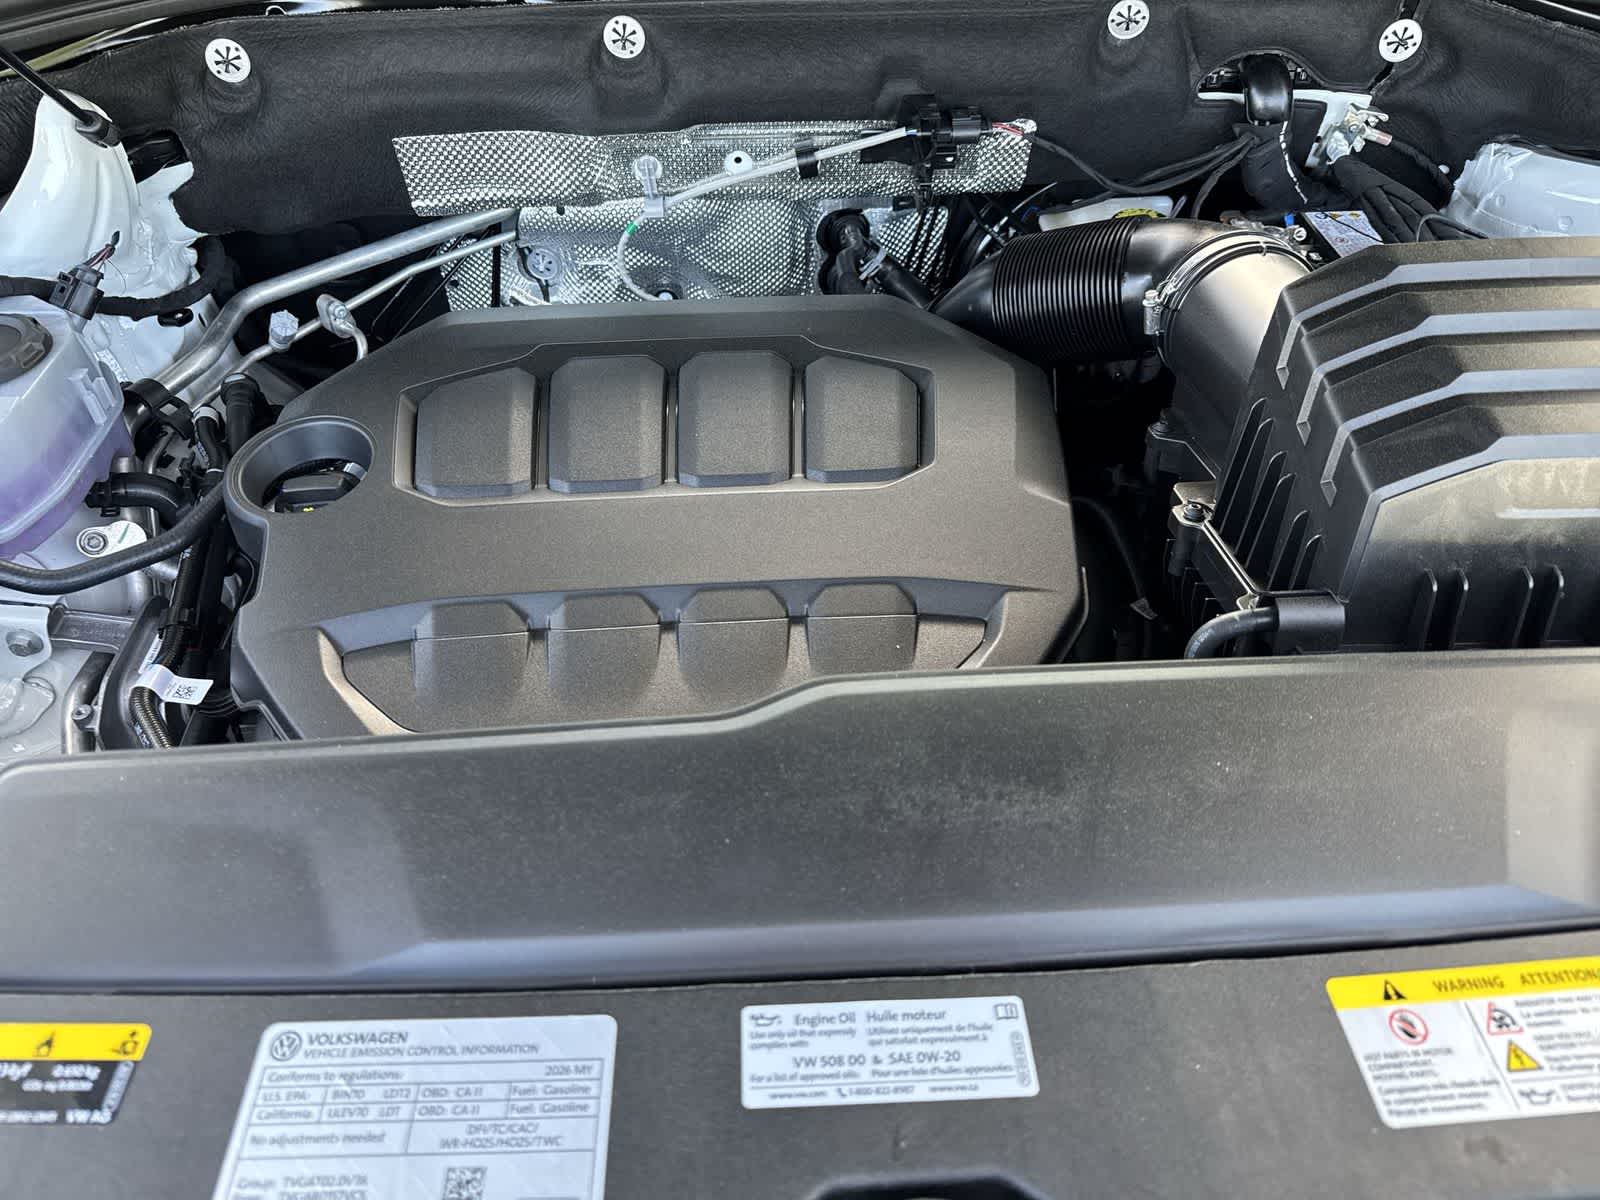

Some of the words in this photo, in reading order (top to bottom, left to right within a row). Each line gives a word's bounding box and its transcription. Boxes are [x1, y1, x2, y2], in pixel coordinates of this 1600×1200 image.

[1432, 975, 1505, 993] WARNING
[794, 1013, 837, 1027] Engine
[839, 1011, 857, 1024] Oil
[867, 1011, 899, 1023] Huile
[901, 1010, 946, 1022] moteur
[307, 1031, 409, 1046] VOLKSWAGEN
[304, 1047, 348, 1059] VEHICLE
[352, 1046, 404, 1058] EMISSION
[407, 1045, 457, 1057] CONTROL
[461, 1044, 540, 1056] INFORMATION
[793, 1056, 817, 1068] VW
[848, 1054, 866, 1066] 00
[872, 1053, 883, 1065] &
[889, 1051, 913, 1064] SAE
[916, 1050, 961, 1063] 0W-20
[543, 1083, 592, 1096] Gasoline
[541, 1102, 591, 1114] Gasoline
